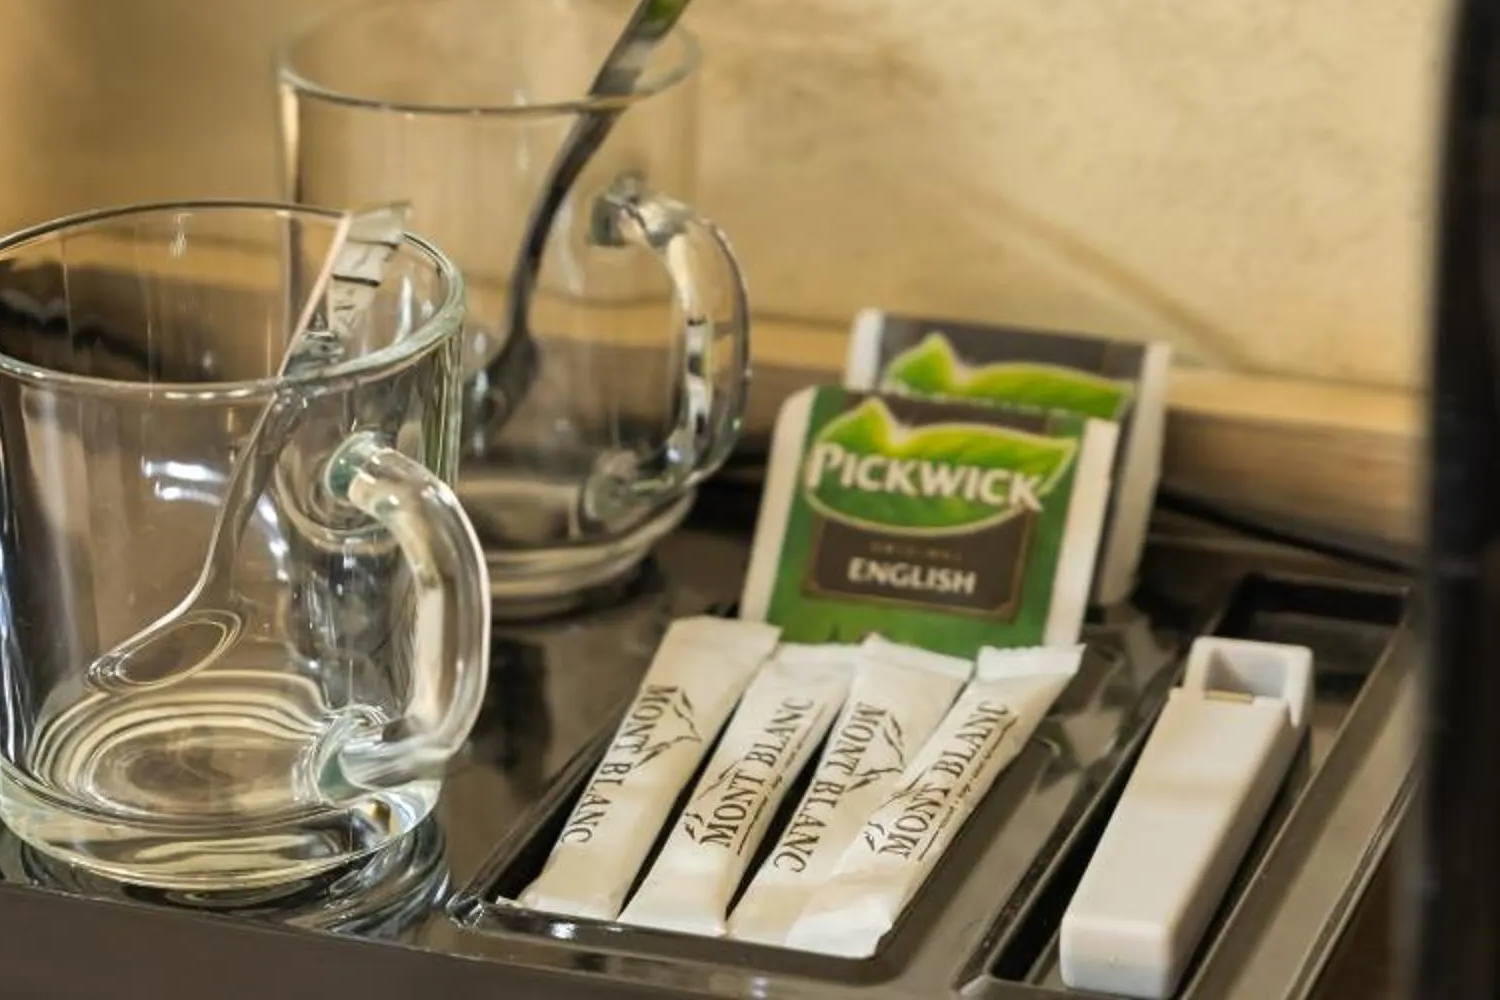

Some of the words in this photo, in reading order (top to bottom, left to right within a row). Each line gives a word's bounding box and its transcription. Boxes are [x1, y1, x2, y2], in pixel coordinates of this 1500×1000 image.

[806, 441, 1044, 512] PICKWICK
[847, 556, 978, 596] ENGLISH
[613, 684, 678, 755] MONT
[825, 701, 887, 777] MONT
[561, 762, 633, 844] BLANC
[699, 769, 766, 849] MONT
[743, 697, 815, 767] BLANC
[877, 783, 952, 860] MONT
[932, 700, 1009, 778] BLANC
[773, 780, 846, 873] BLANC
